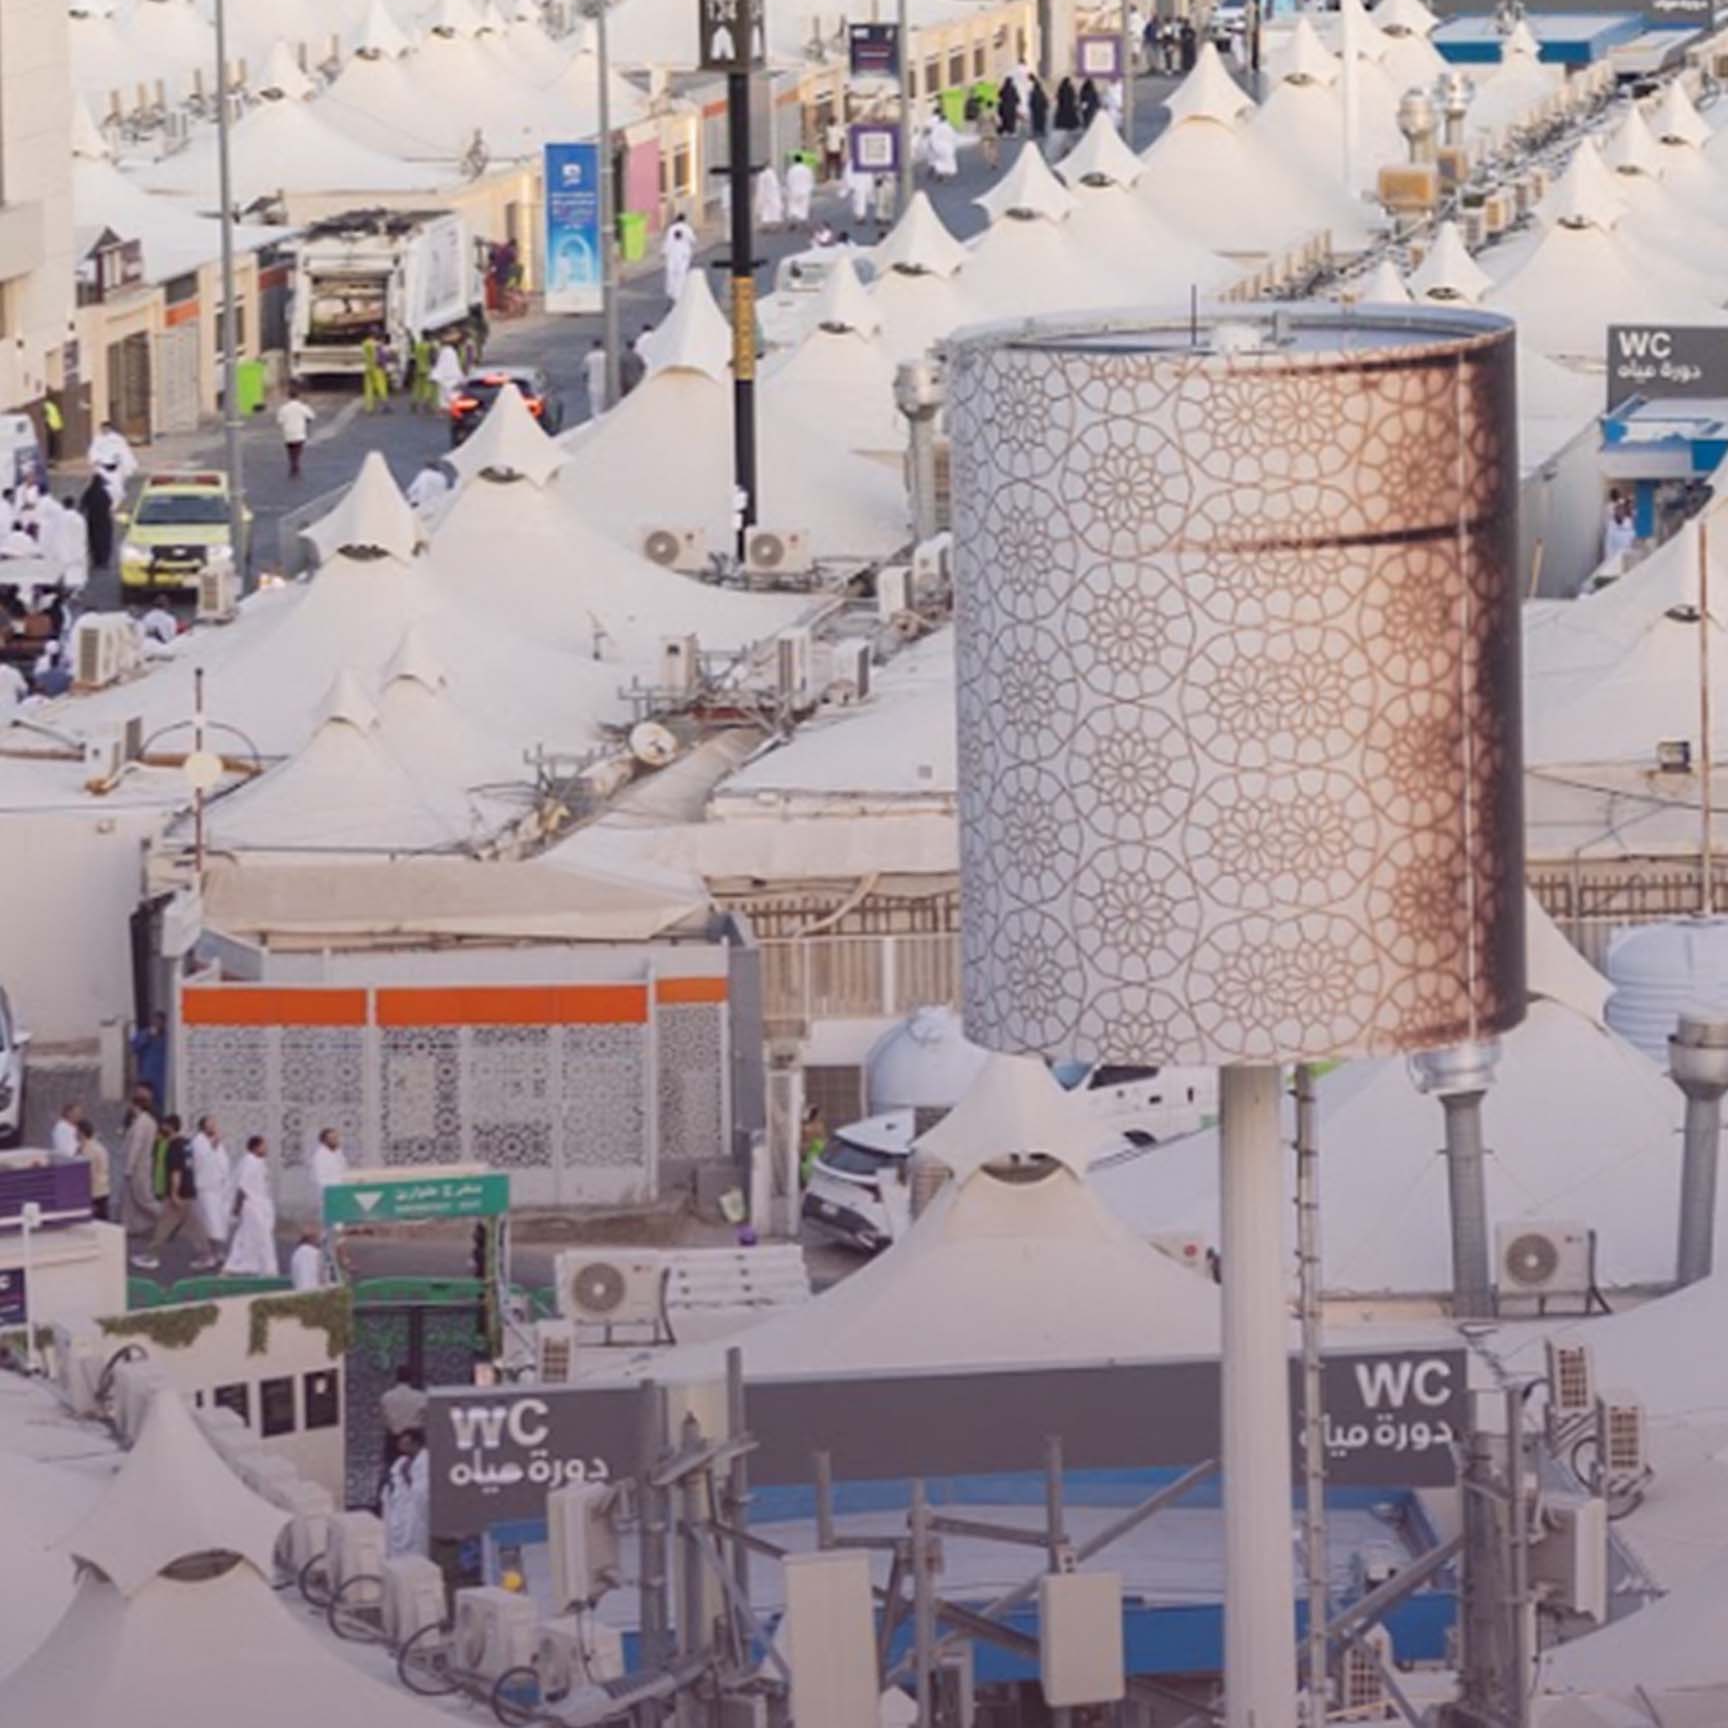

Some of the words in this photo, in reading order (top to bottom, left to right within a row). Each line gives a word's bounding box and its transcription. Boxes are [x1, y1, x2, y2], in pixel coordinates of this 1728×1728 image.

[1619, 331, 1672, 359] WC
[1618, 358, 1656, 384] مياه
[1355, 1359, 1452, 1408] WC
[450, 1398, 549, 1449] WC
[1374, 1413, 1452, 1451] دورة
[449, 1448, 524, 1494] مياه
[528, 1448, 609, 1488] دورة
